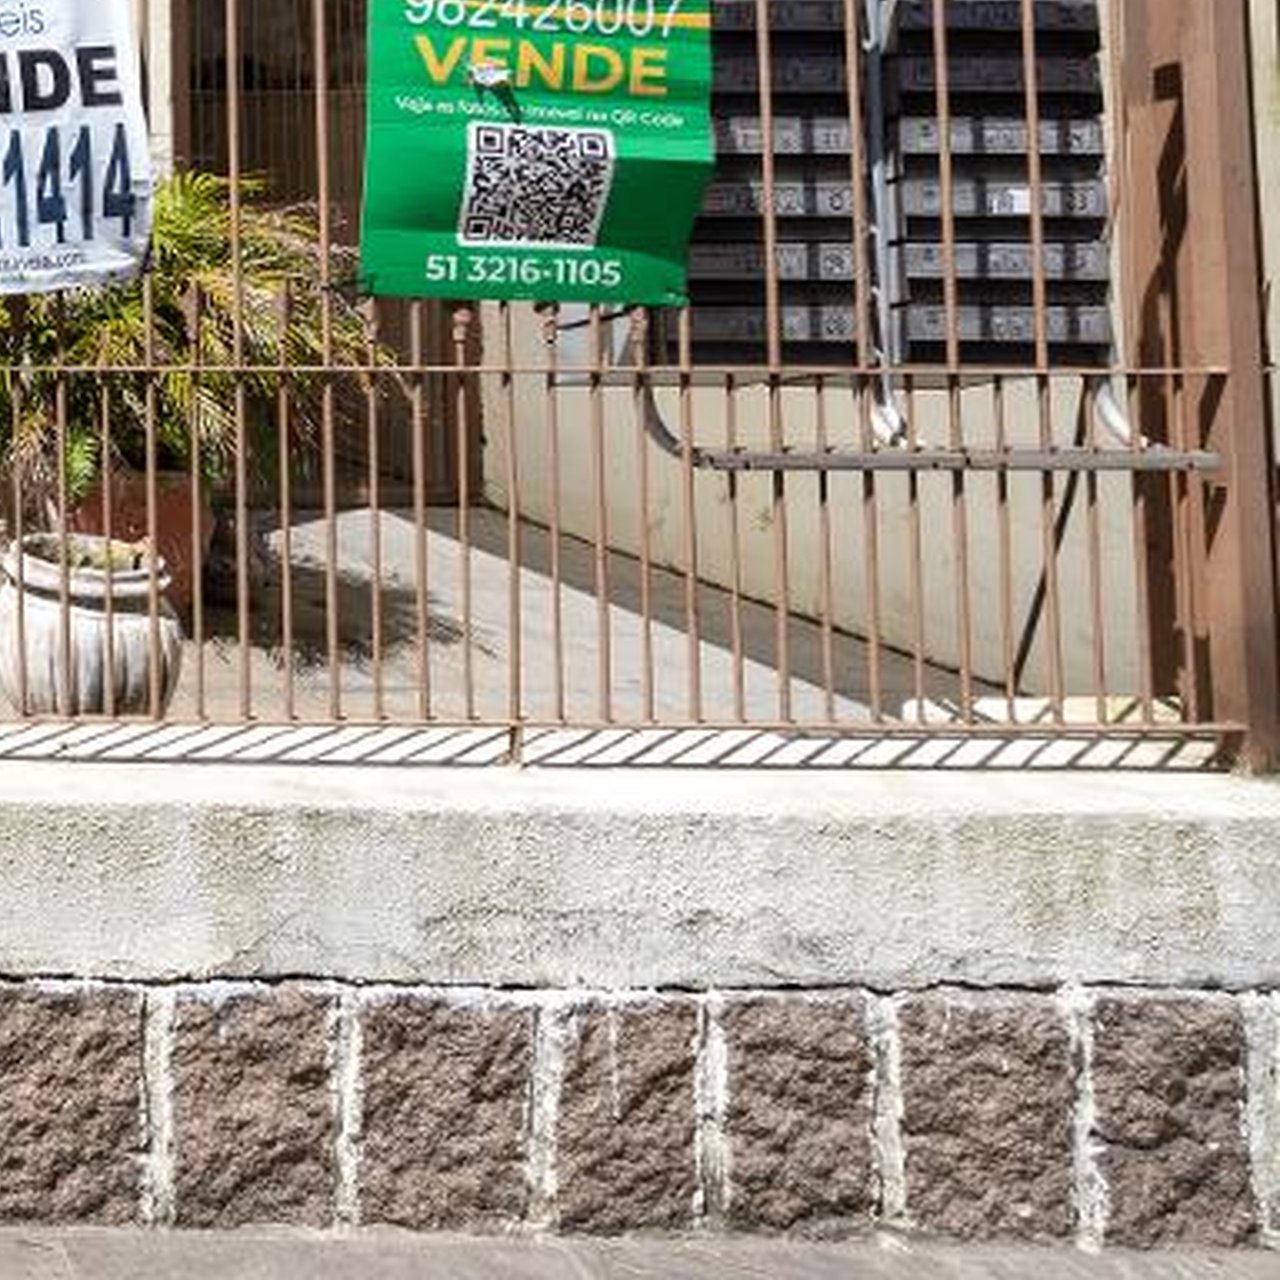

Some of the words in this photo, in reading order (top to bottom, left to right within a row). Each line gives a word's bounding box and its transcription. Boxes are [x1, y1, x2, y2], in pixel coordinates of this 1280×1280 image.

[414, 34, 668, 96] VENDE
[427, 254, 458, 281] 51
[468, 257, 621, 287] 3216-1105
